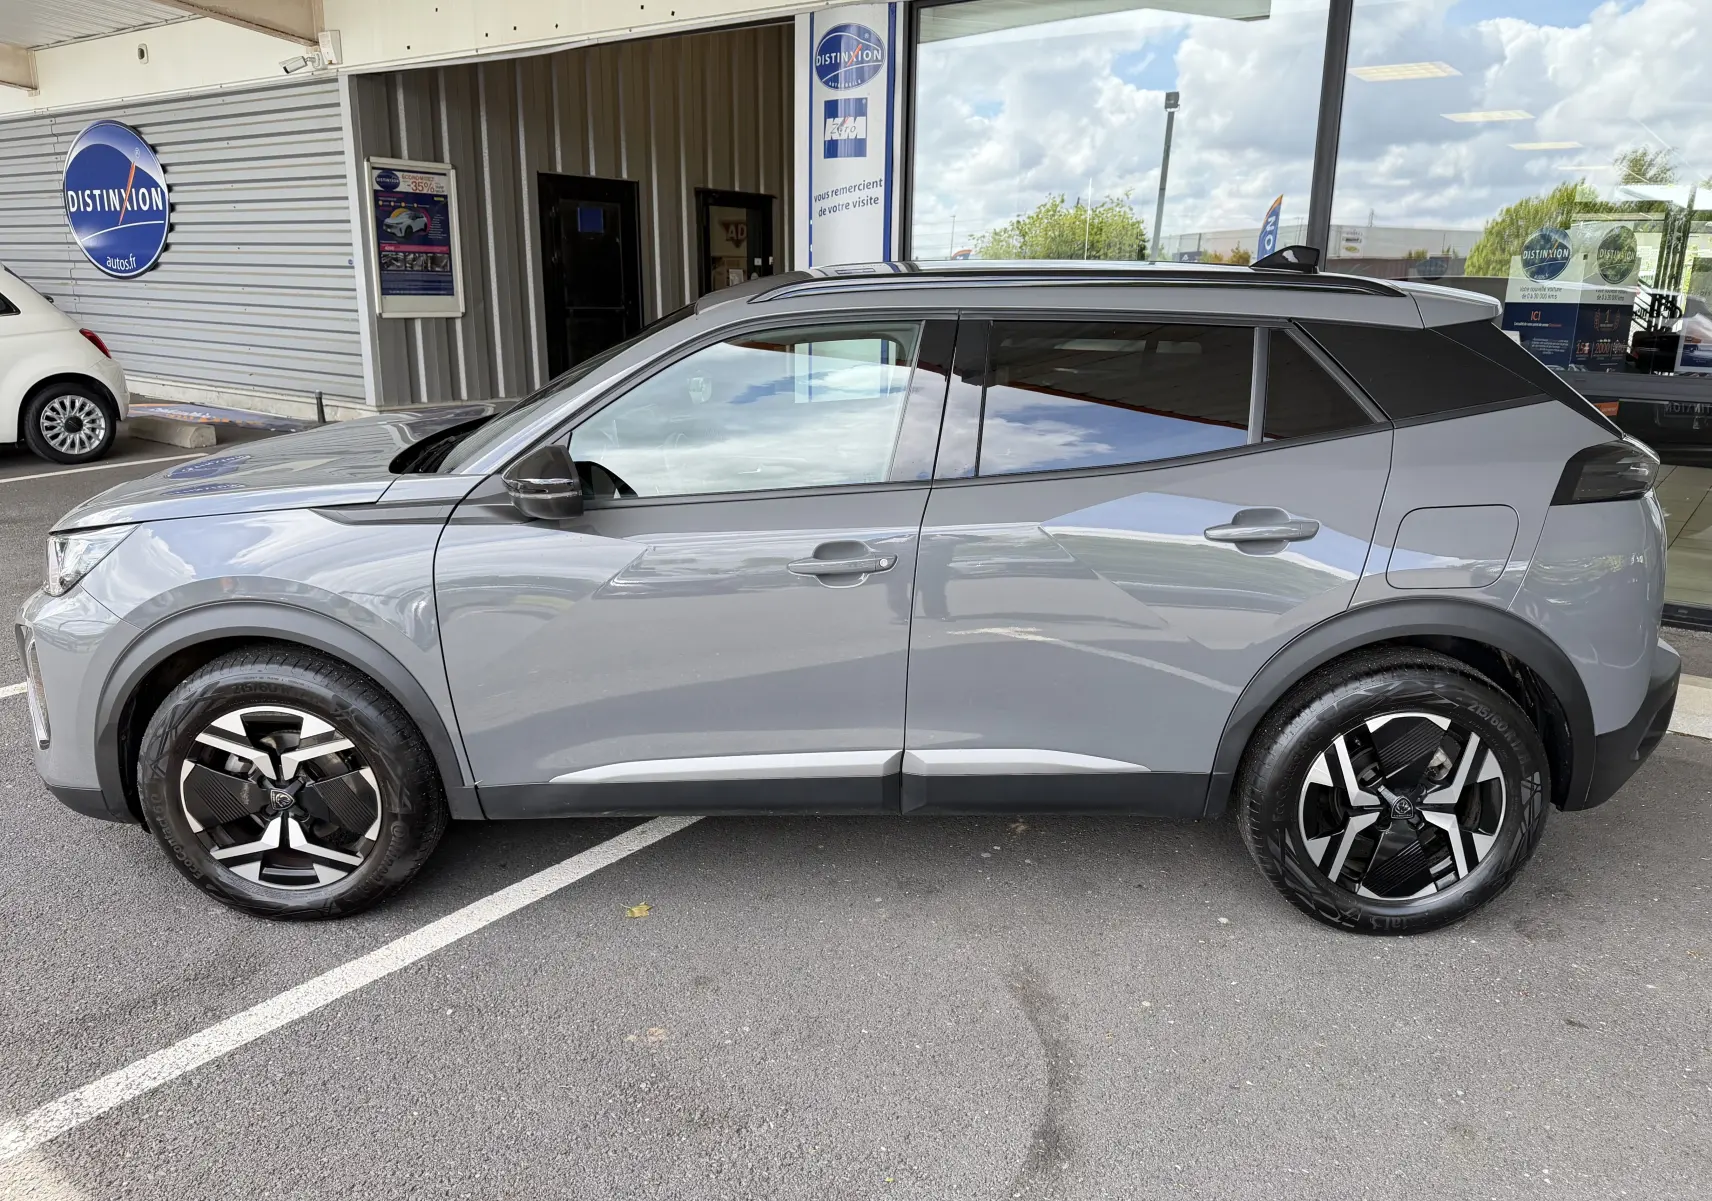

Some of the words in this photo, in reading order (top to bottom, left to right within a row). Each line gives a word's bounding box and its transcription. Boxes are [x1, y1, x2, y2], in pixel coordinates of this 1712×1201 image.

[816, 49, 882, 67] DISTINXION
[67, 187, 163, 213] DISTINXION
[813, 190, 830, 203] vous
[830, 178, 883, 198] remercient
[818, 206, 827, 218] de
[828, 202, 850, 215] votre
[852, 195, 880, 209] visite
[106, 253, 136, 271] autos.fr
[1522, 249, 1569, 260] DISTINXION
[1467, 699, 1509, 733] 215/60
